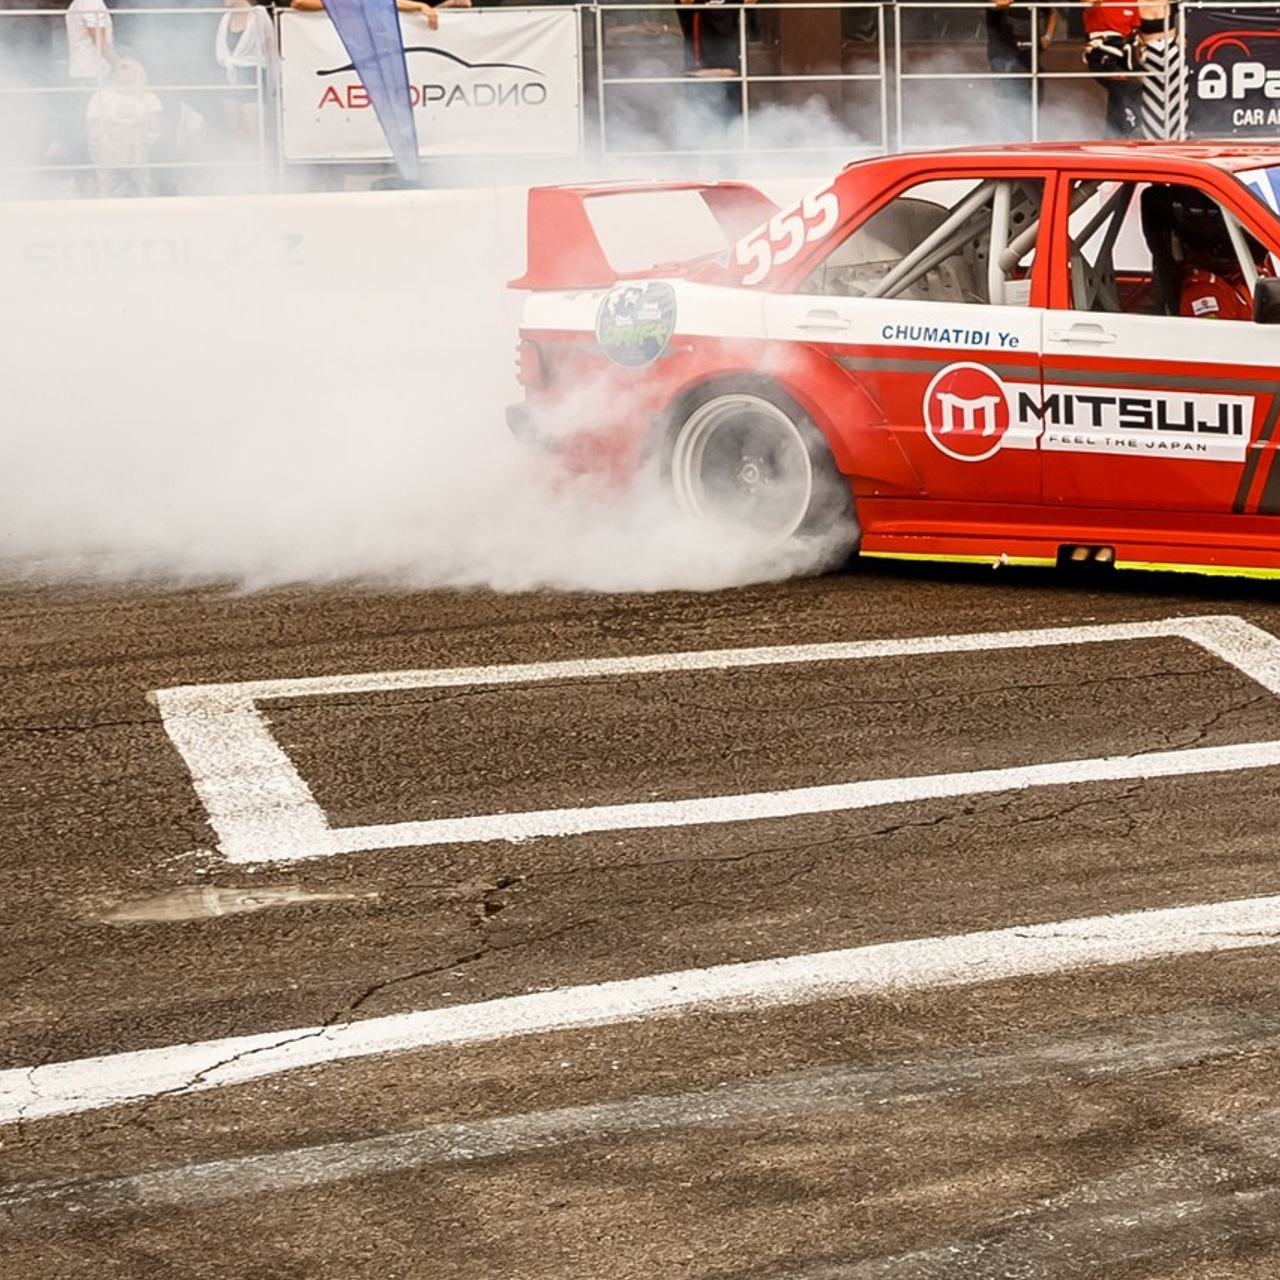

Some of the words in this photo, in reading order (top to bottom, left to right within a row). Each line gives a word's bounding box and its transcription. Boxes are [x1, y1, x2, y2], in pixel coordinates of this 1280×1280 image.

[1232, 108, 1264, 126] CAR
[735, 179, 839, 286] 555
[881, 325, 991, 346] CHUMATIDI
[998, 332, 1020, 348] Ye
[1018, 391, 1244, 435] MITSUJI
[1049, 436, 1096, 445] FEEL
[1105, 437, 1138, 448] THE
[1145, 440, 1208, 452] JAPAN
